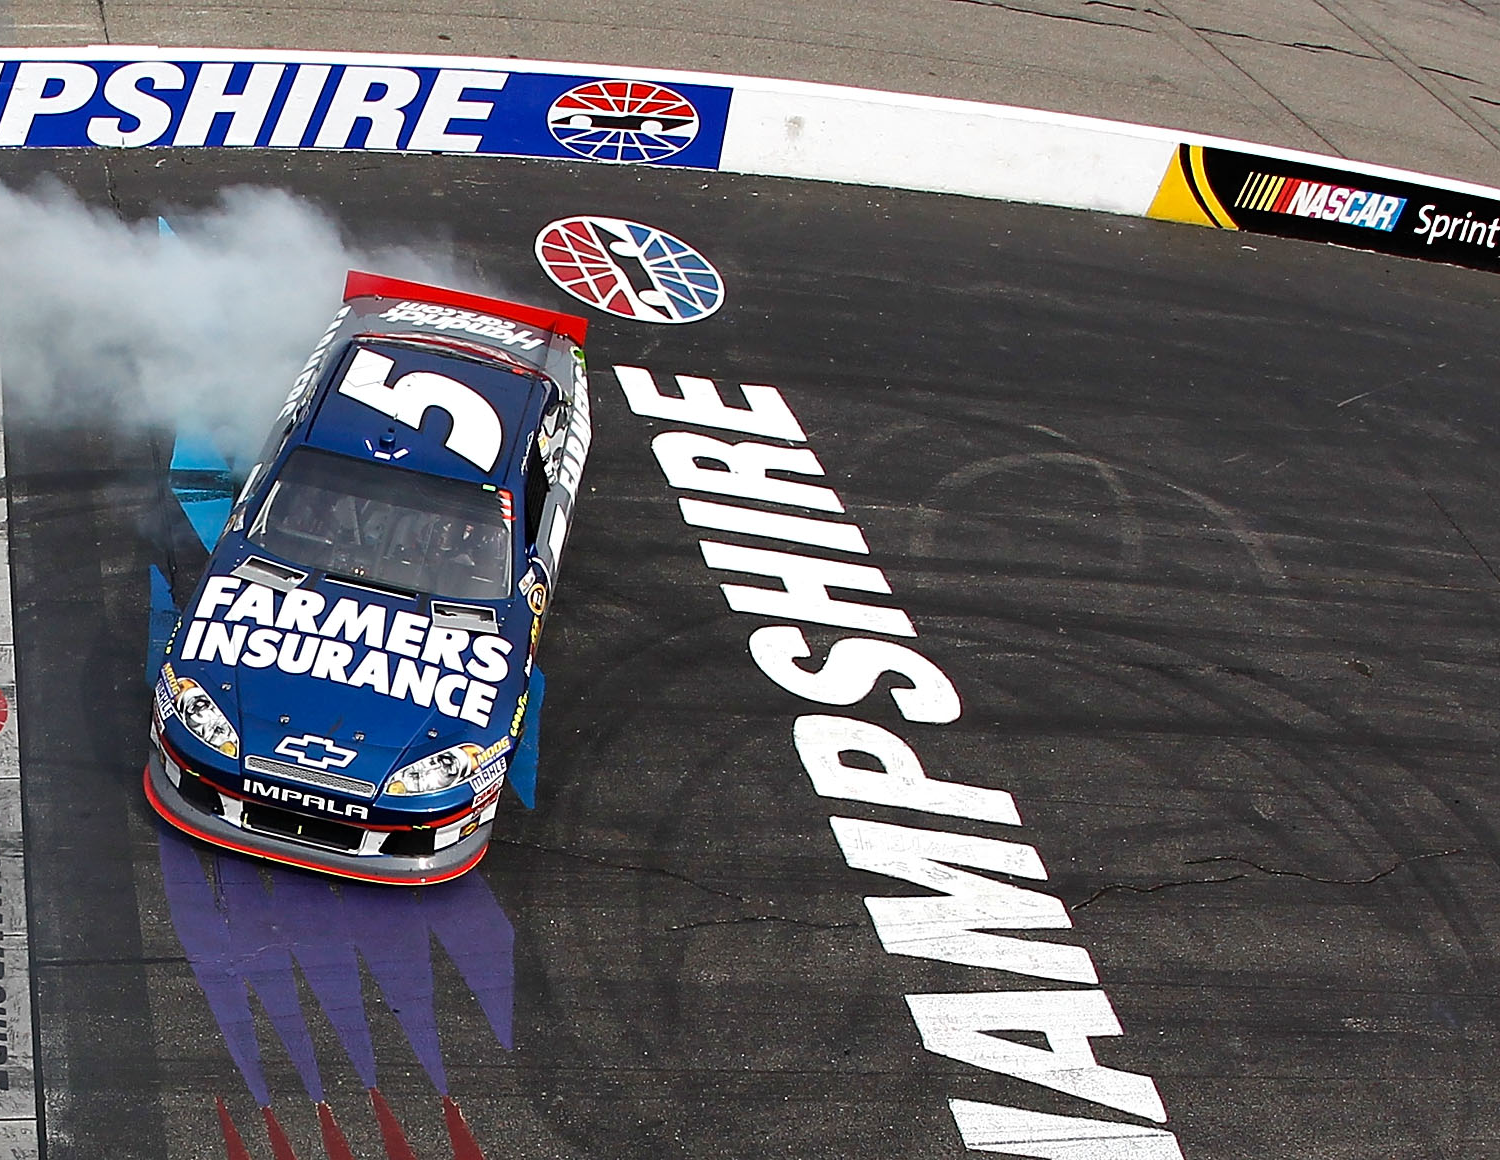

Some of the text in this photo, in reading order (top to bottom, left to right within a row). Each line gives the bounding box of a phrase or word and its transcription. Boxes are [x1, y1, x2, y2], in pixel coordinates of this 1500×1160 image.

[1286, 182, 1500, 248] NASCAR Sprint
[338, 348, 504, 473] 5
[195, 576, 513, 682] FARMERS
[163, 663, 181, 696] MOOG
[180, 620, 499, 728] INSURANCE
[471, 758, 506, 790] MAHLE
[477, 735, 510, 763] MOOG
[243, 779, 369, 820] IMPALA
